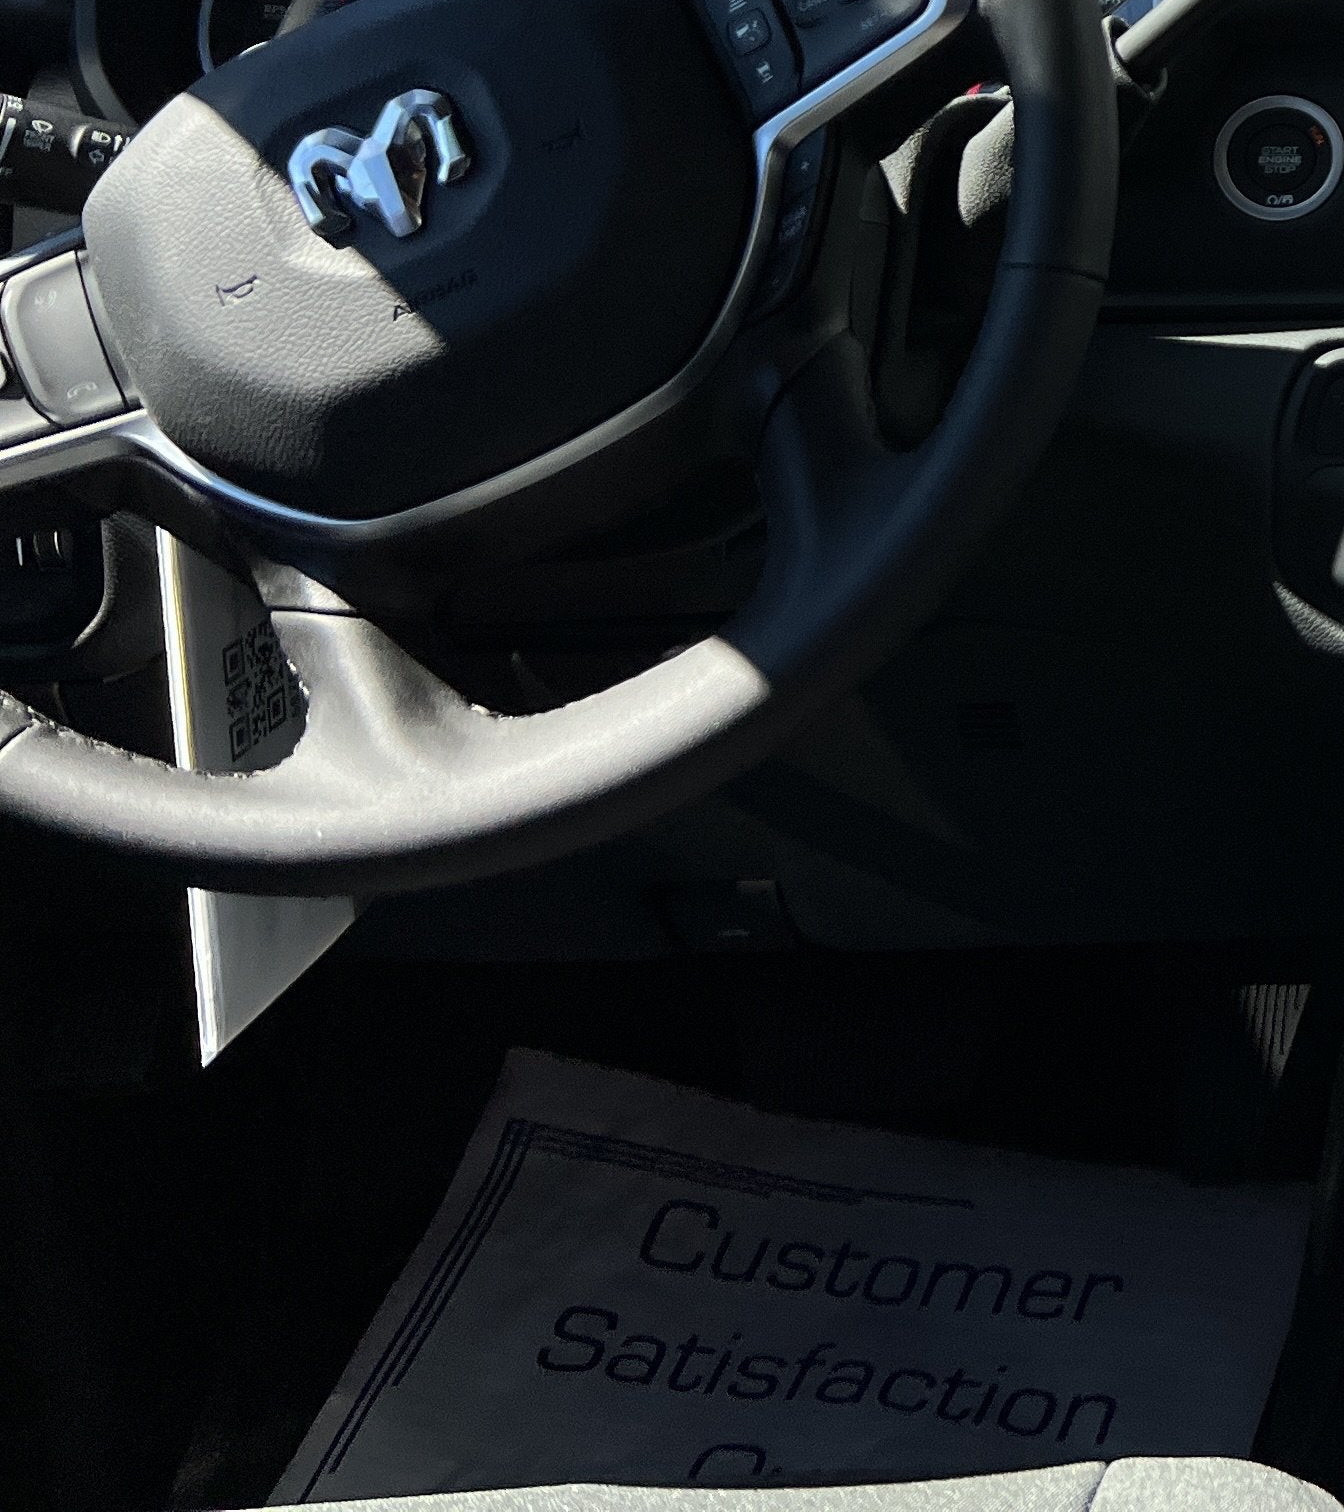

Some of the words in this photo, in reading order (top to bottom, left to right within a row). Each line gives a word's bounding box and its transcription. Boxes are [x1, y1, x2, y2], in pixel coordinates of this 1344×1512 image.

[1261, 146, 1299, 155] START
[1257, 155, 1302, 164] ENGINE
[1264, 164, 1297, 174] STOP
[640, 1199, 1124, 1323] Customer
[537, 1305, 1119, 1445] Satisfaction
